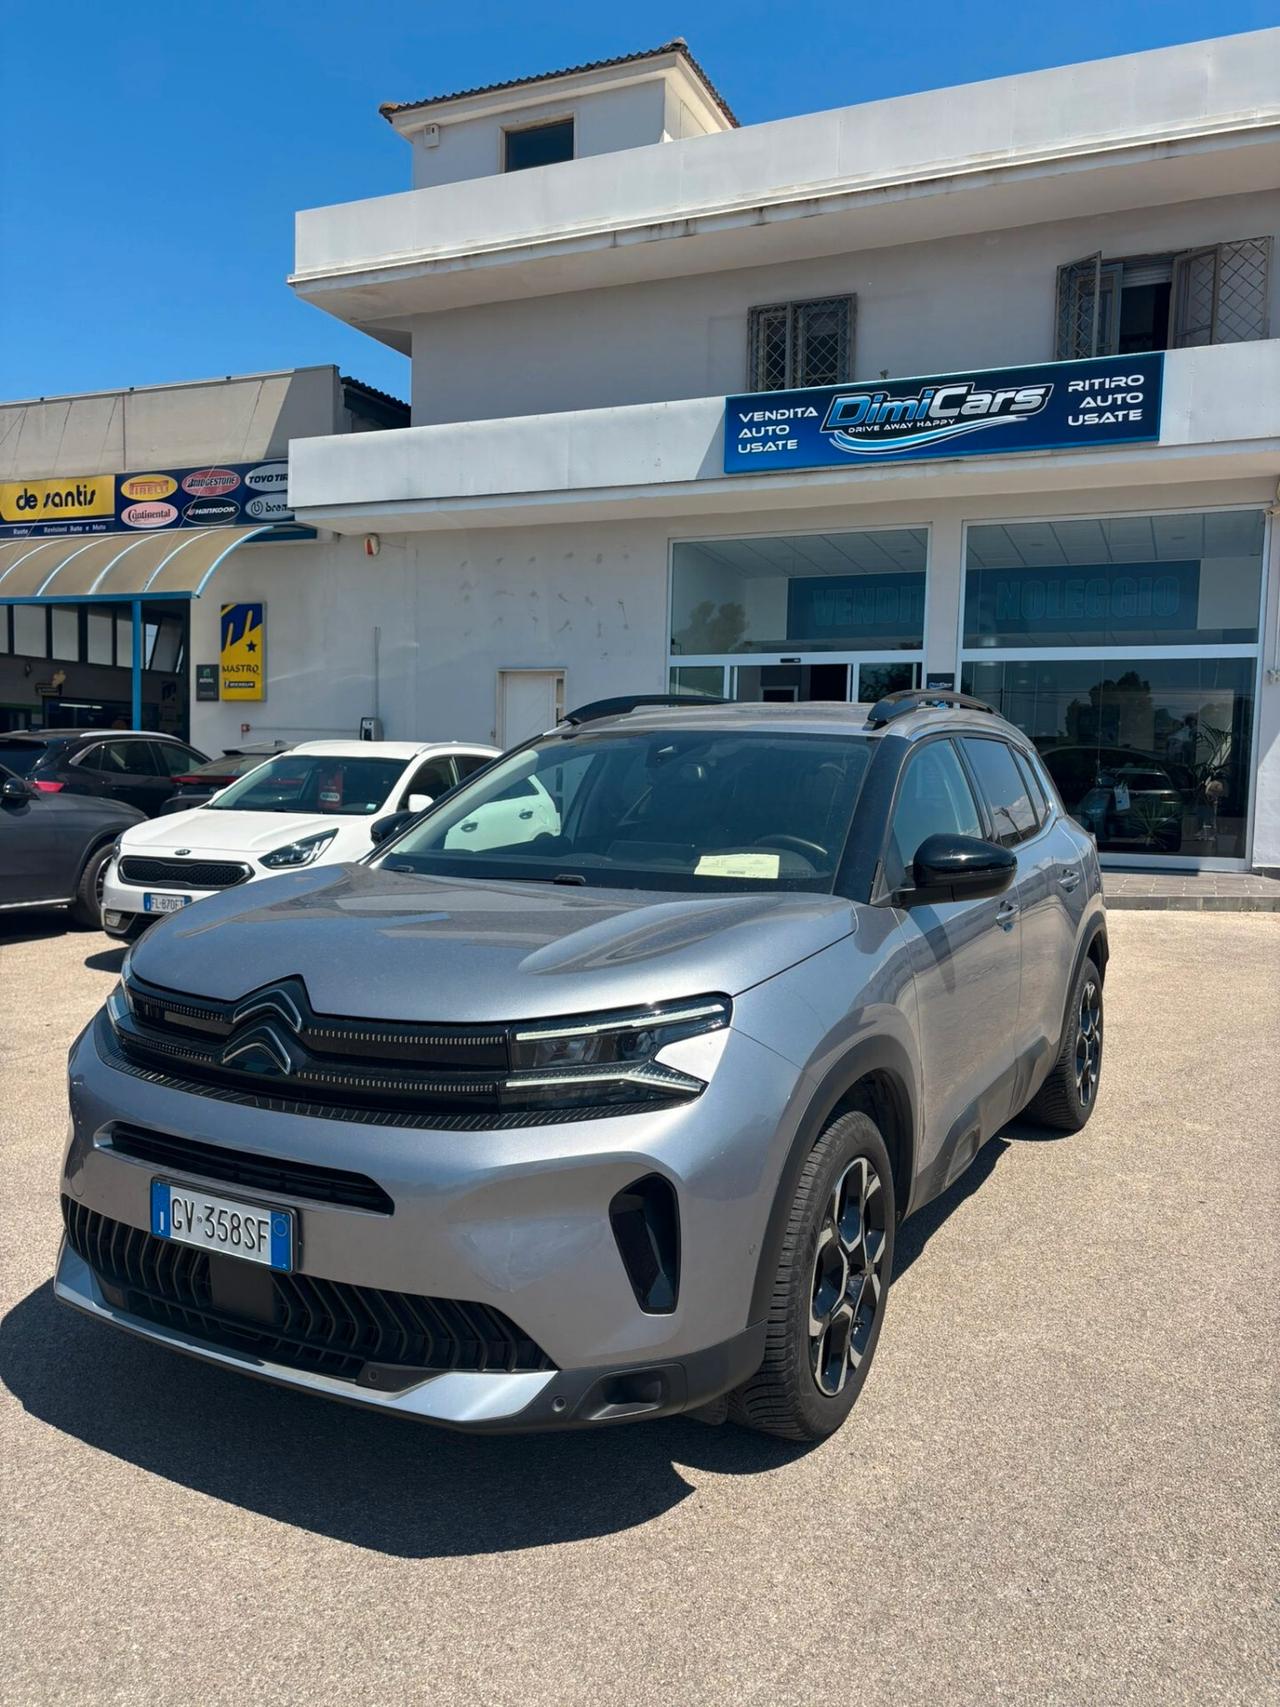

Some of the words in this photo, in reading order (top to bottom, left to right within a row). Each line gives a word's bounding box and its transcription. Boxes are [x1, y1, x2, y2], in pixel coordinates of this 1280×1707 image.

[1068, 374, 1145, 392] RITIRO
[826, 386, 1047, 427] DimiCars
[1079, 392, 1144, 408] AUTO
[738, 406, 819, 423] VENDITA
[1068, 409, 1143, 426] USATE
[738, 425, 790, 438] AUTO
[848, 425, 880, 433] DRIVE
[883, 422, 915, 431] AWAY
[916, 419, 955, 428] HAPPY
[738, 439, 798, 453] USATE
[187, 477, 235, 488] BRIDGESTONE
[249, 474, 274, 484] TOYO
[128, 480, 170, 496] PIRELLI
[16, 488, 38, 510] de
[43, 484, 96, 508] santis
[128, 509, 171, 522] Continental
[995, 576, 1181, 620] NOLEGGIO
